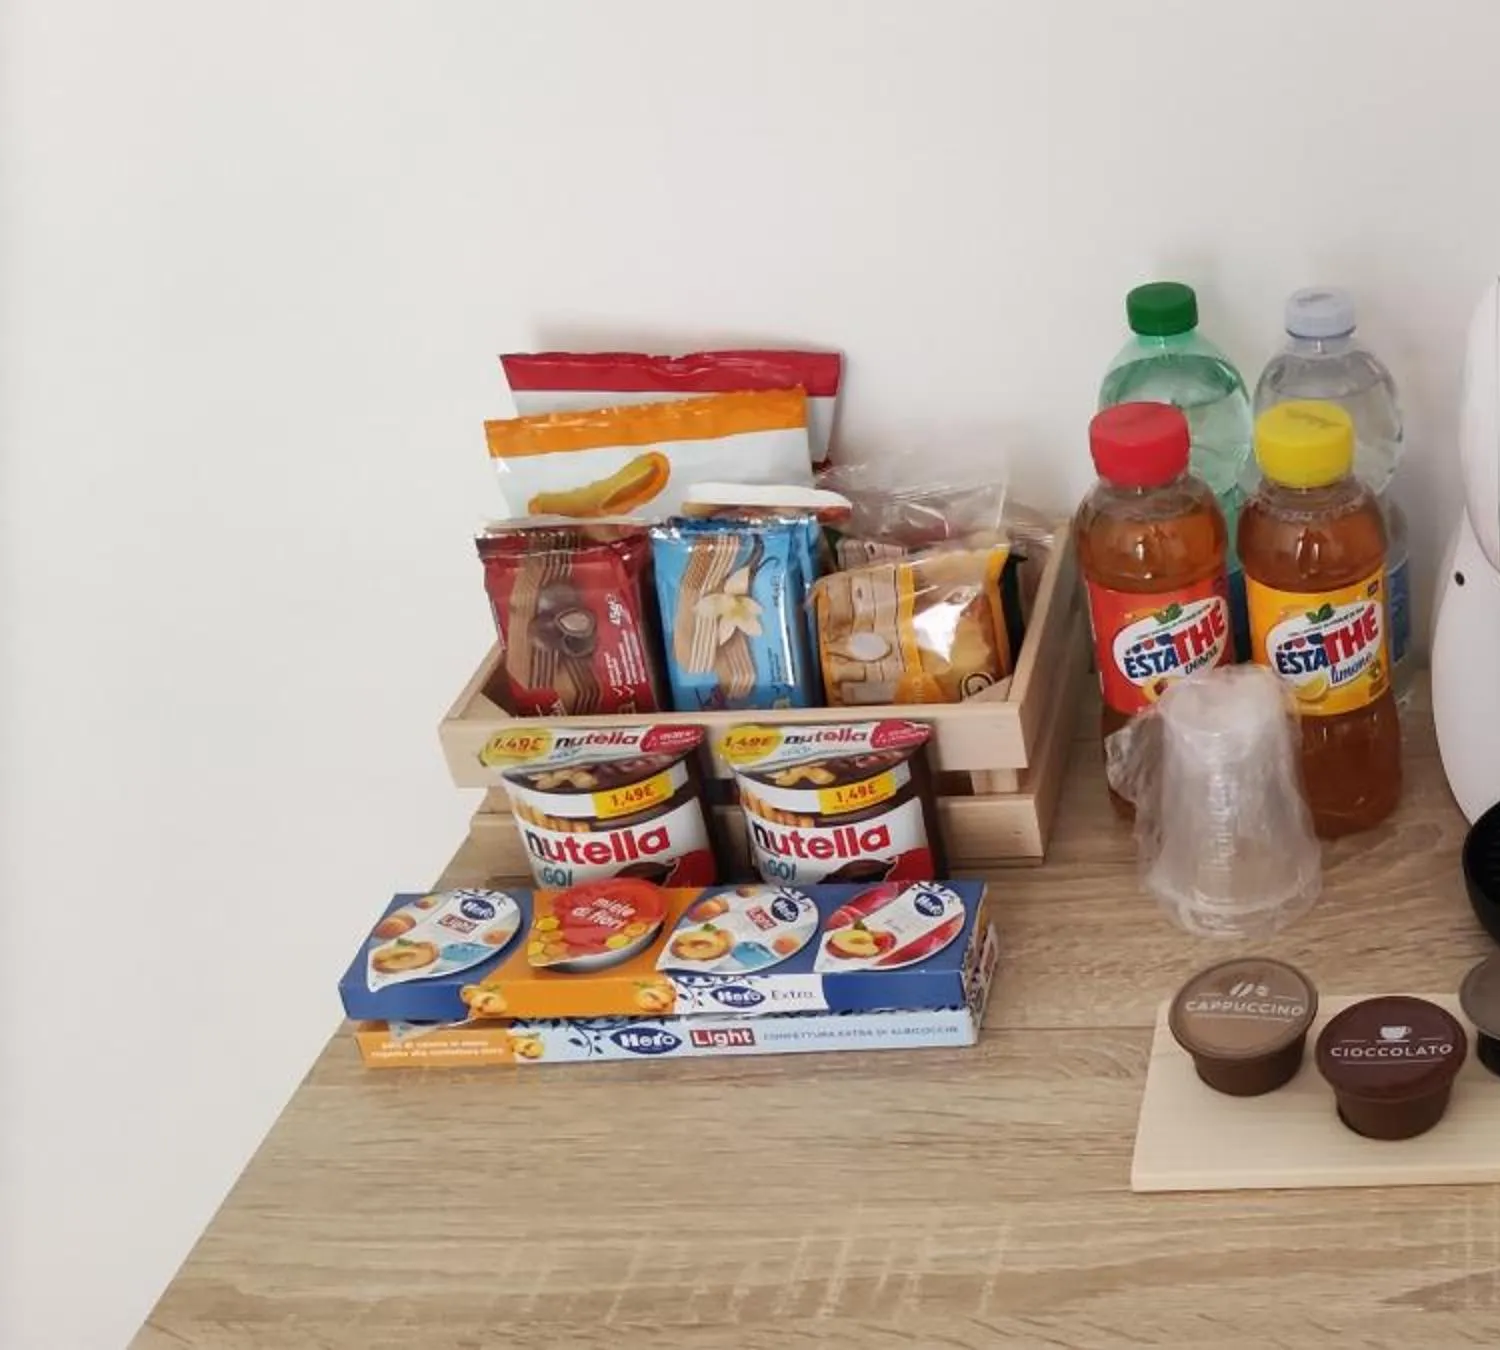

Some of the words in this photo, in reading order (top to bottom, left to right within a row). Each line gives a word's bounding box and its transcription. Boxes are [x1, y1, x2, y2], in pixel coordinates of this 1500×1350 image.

[555, 731, 639, 750] nutella
[783, 728, 867, 745] nutella
[525, 825, 671, 866] nutella
[750, 820, 891, 861] nutella
[1185, 1000, 1305, 1018] CAPPUCCINO
[620, 1031, 676, 1049] Hero
[692, 1028, 754, 1048] Light
[1330, 1043, 1454, 1058] CIOCCOLATO
